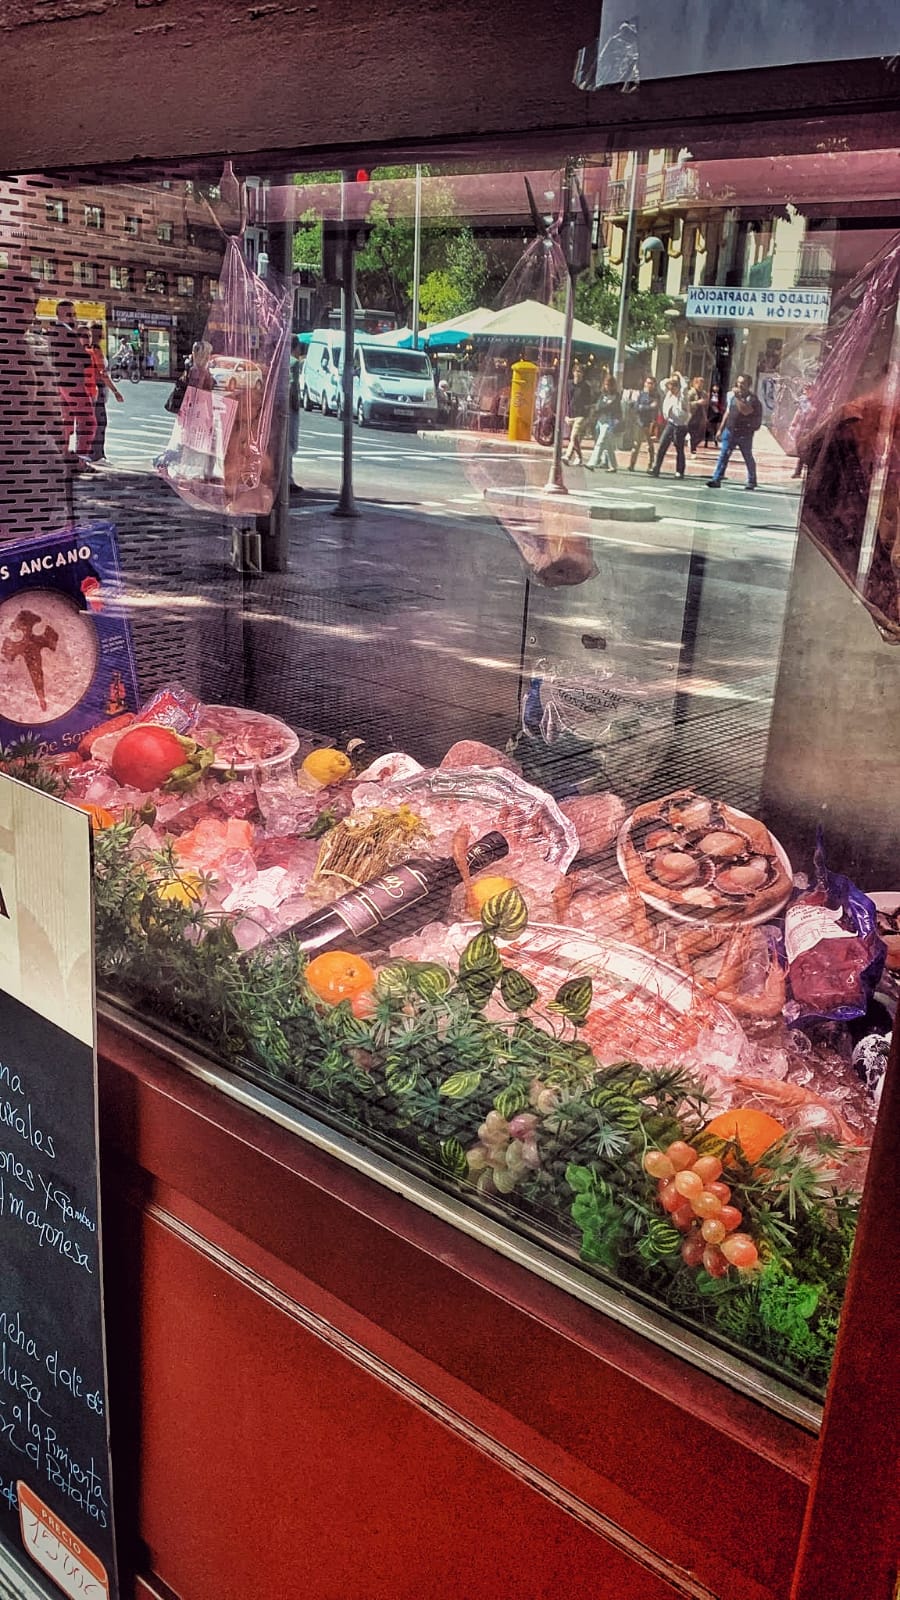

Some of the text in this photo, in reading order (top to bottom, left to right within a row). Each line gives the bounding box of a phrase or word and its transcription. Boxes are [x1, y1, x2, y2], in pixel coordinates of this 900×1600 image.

[19, 545, 91, 576] ANCANO
[9, 1192, 93, 1274] mayonesa
[41, 1508, 81, 1554] PRECIO
